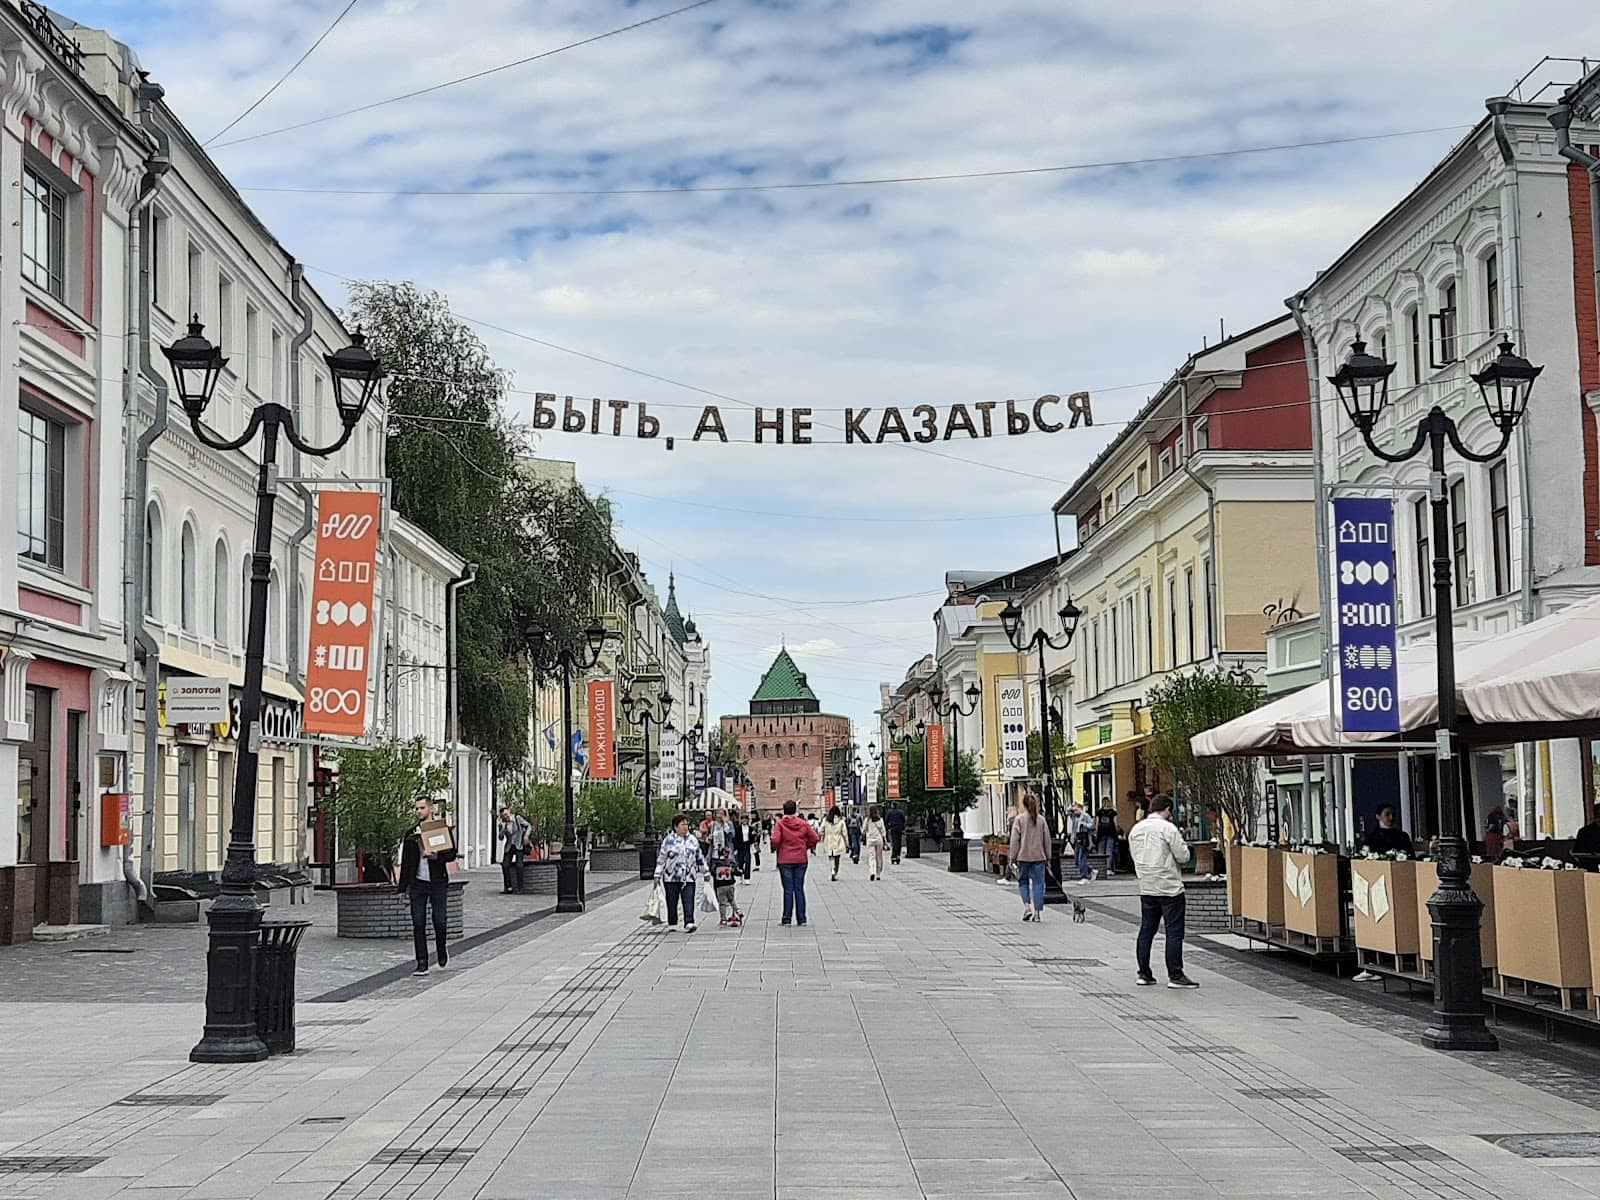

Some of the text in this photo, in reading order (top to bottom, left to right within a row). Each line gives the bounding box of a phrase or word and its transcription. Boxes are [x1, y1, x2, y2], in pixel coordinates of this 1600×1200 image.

[533, 391, 1094, 450] БЫТЬ, А НЕ КАЗАТЬСЯ
[309, 687, 361, 715] 800
[1346, 687, 1393, 712] 800
[1005, 757, 1025, 768] 800
